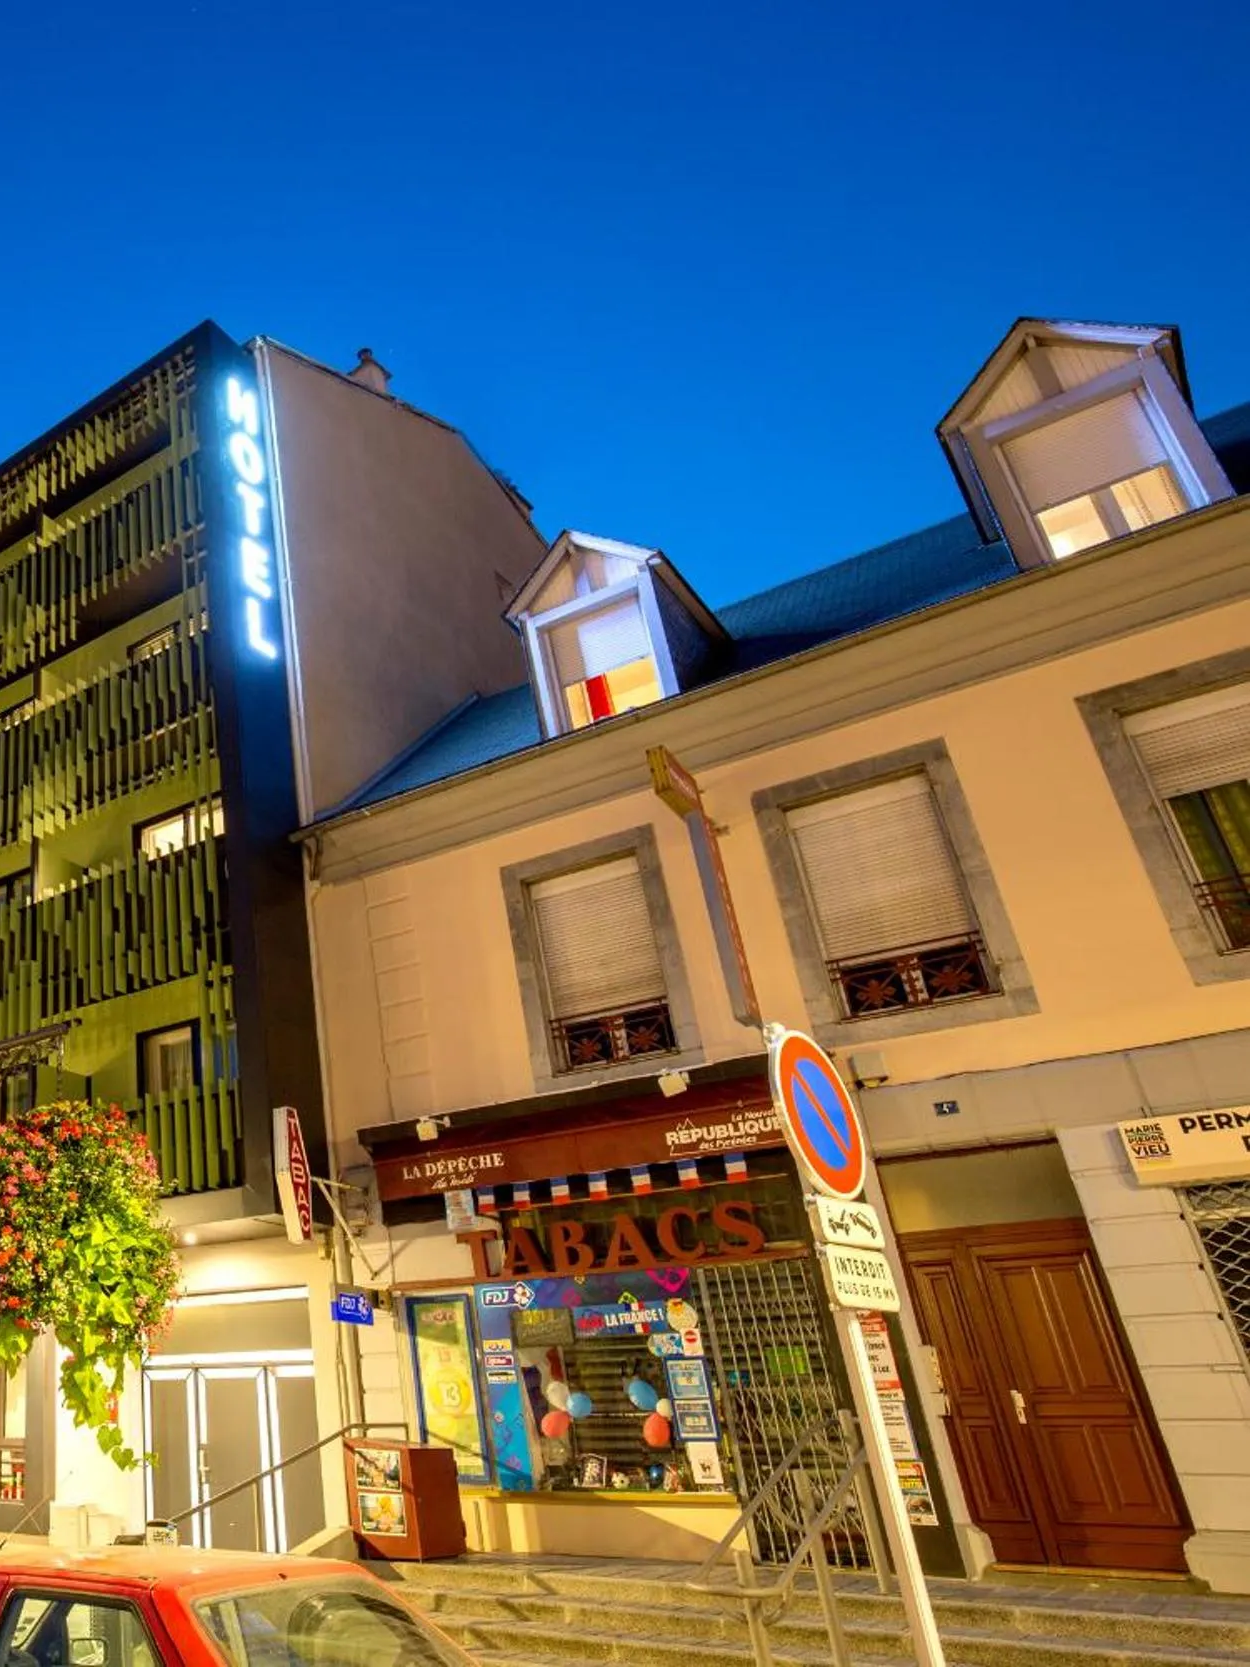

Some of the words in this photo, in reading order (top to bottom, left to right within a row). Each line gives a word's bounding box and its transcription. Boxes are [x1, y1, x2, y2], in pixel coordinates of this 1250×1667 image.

[227, 376, 277, 660] HOTEL
[1124, 1122, 1162, 1134] MARIE
[1132, 1143, 1170, 1157] VIEU
[288, 1117, 310, 1232] TABAC
[403, 1166, 421, 1180] LA
[425, 1152, 505, 1177] DÉPÊCHE
[456, 1200, 766, 1281] TABACS
[834, 1255, 887, 1280] INTERDIT
[485, 1290, 510, 1304] FDJ
[604, 1313, 619, 1327] LA
[618, 1309, 658, 1325] FRANCE
